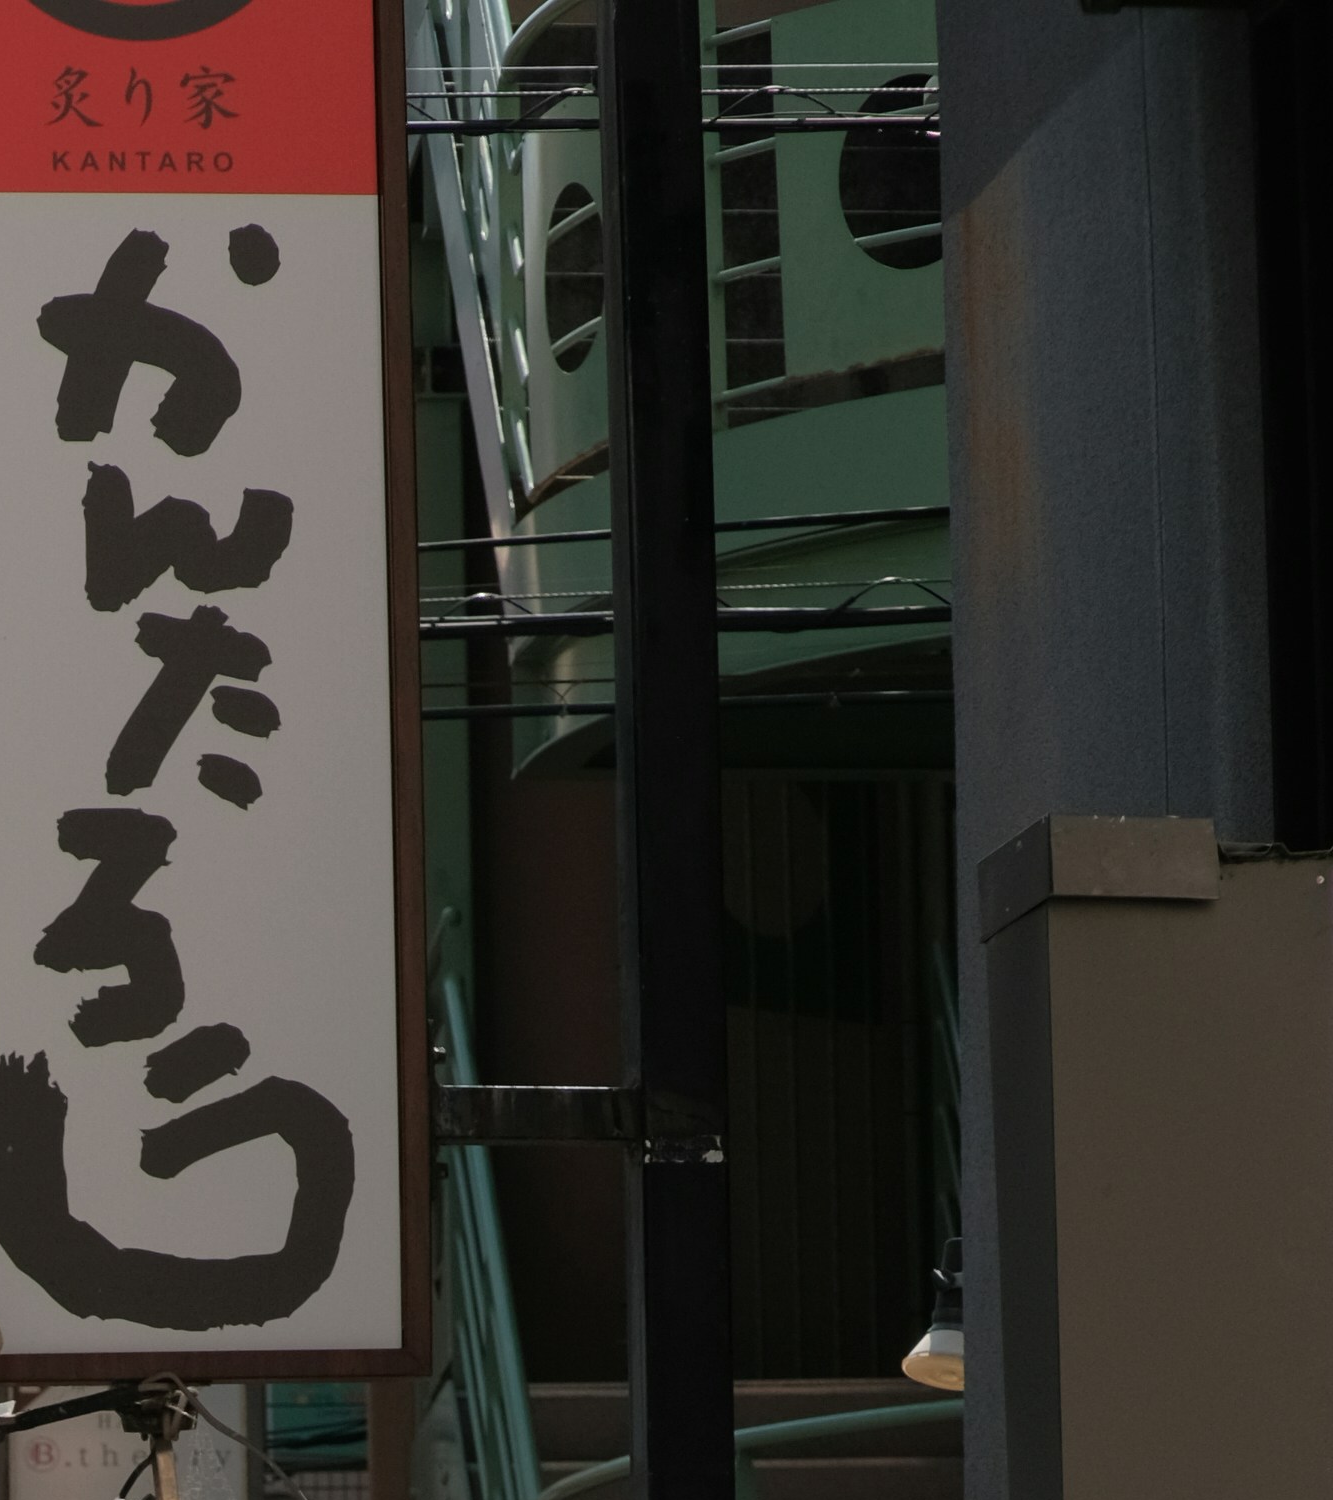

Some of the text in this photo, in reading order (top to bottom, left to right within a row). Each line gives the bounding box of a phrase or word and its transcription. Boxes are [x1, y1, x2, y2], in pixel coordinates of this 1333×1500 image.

[44, 65, 240, 129] 炙り家
[52, 150, 234, 172] KANTARO
[28, 1434, 233, 1474] B.thery
